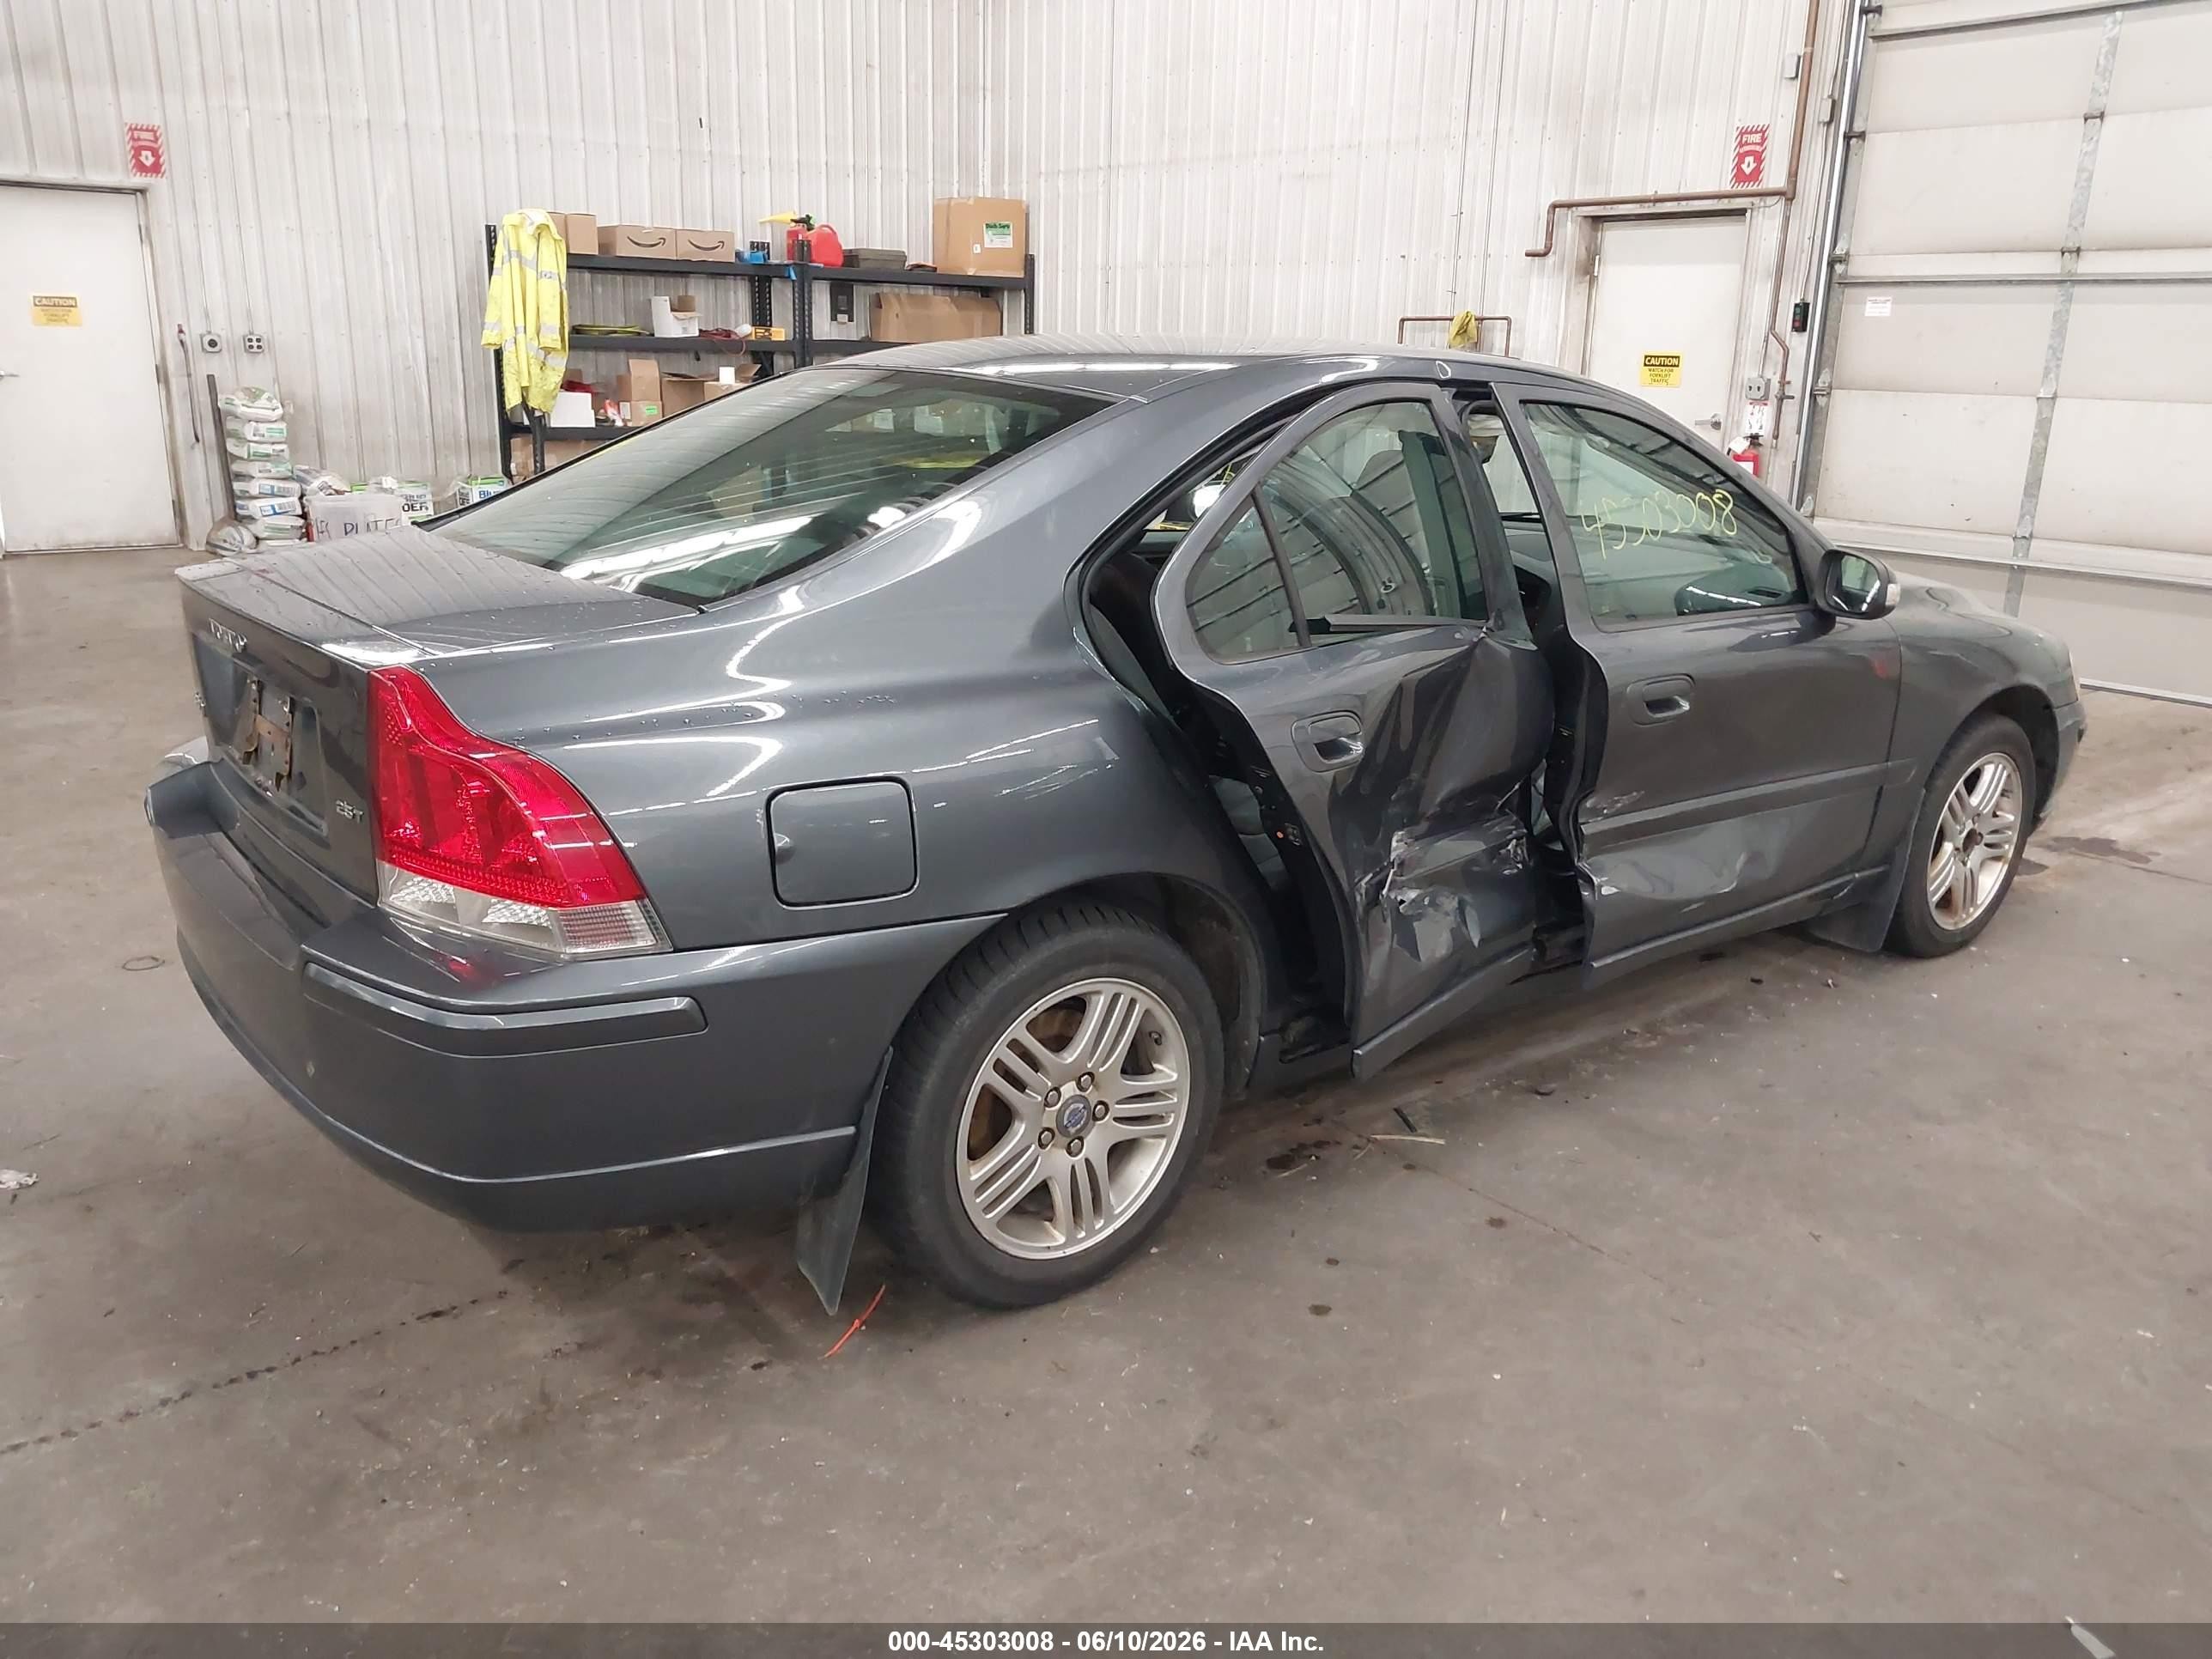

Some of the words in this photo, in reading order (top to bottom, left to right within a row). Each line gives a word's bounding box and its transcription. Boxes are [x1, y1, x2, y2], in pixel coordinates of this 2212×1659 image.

[1742, 133, 1762, 143] FIRE
[34, 298, 76, 307] CAUTION
[1645, 356, 1679, 366] CAUTION
